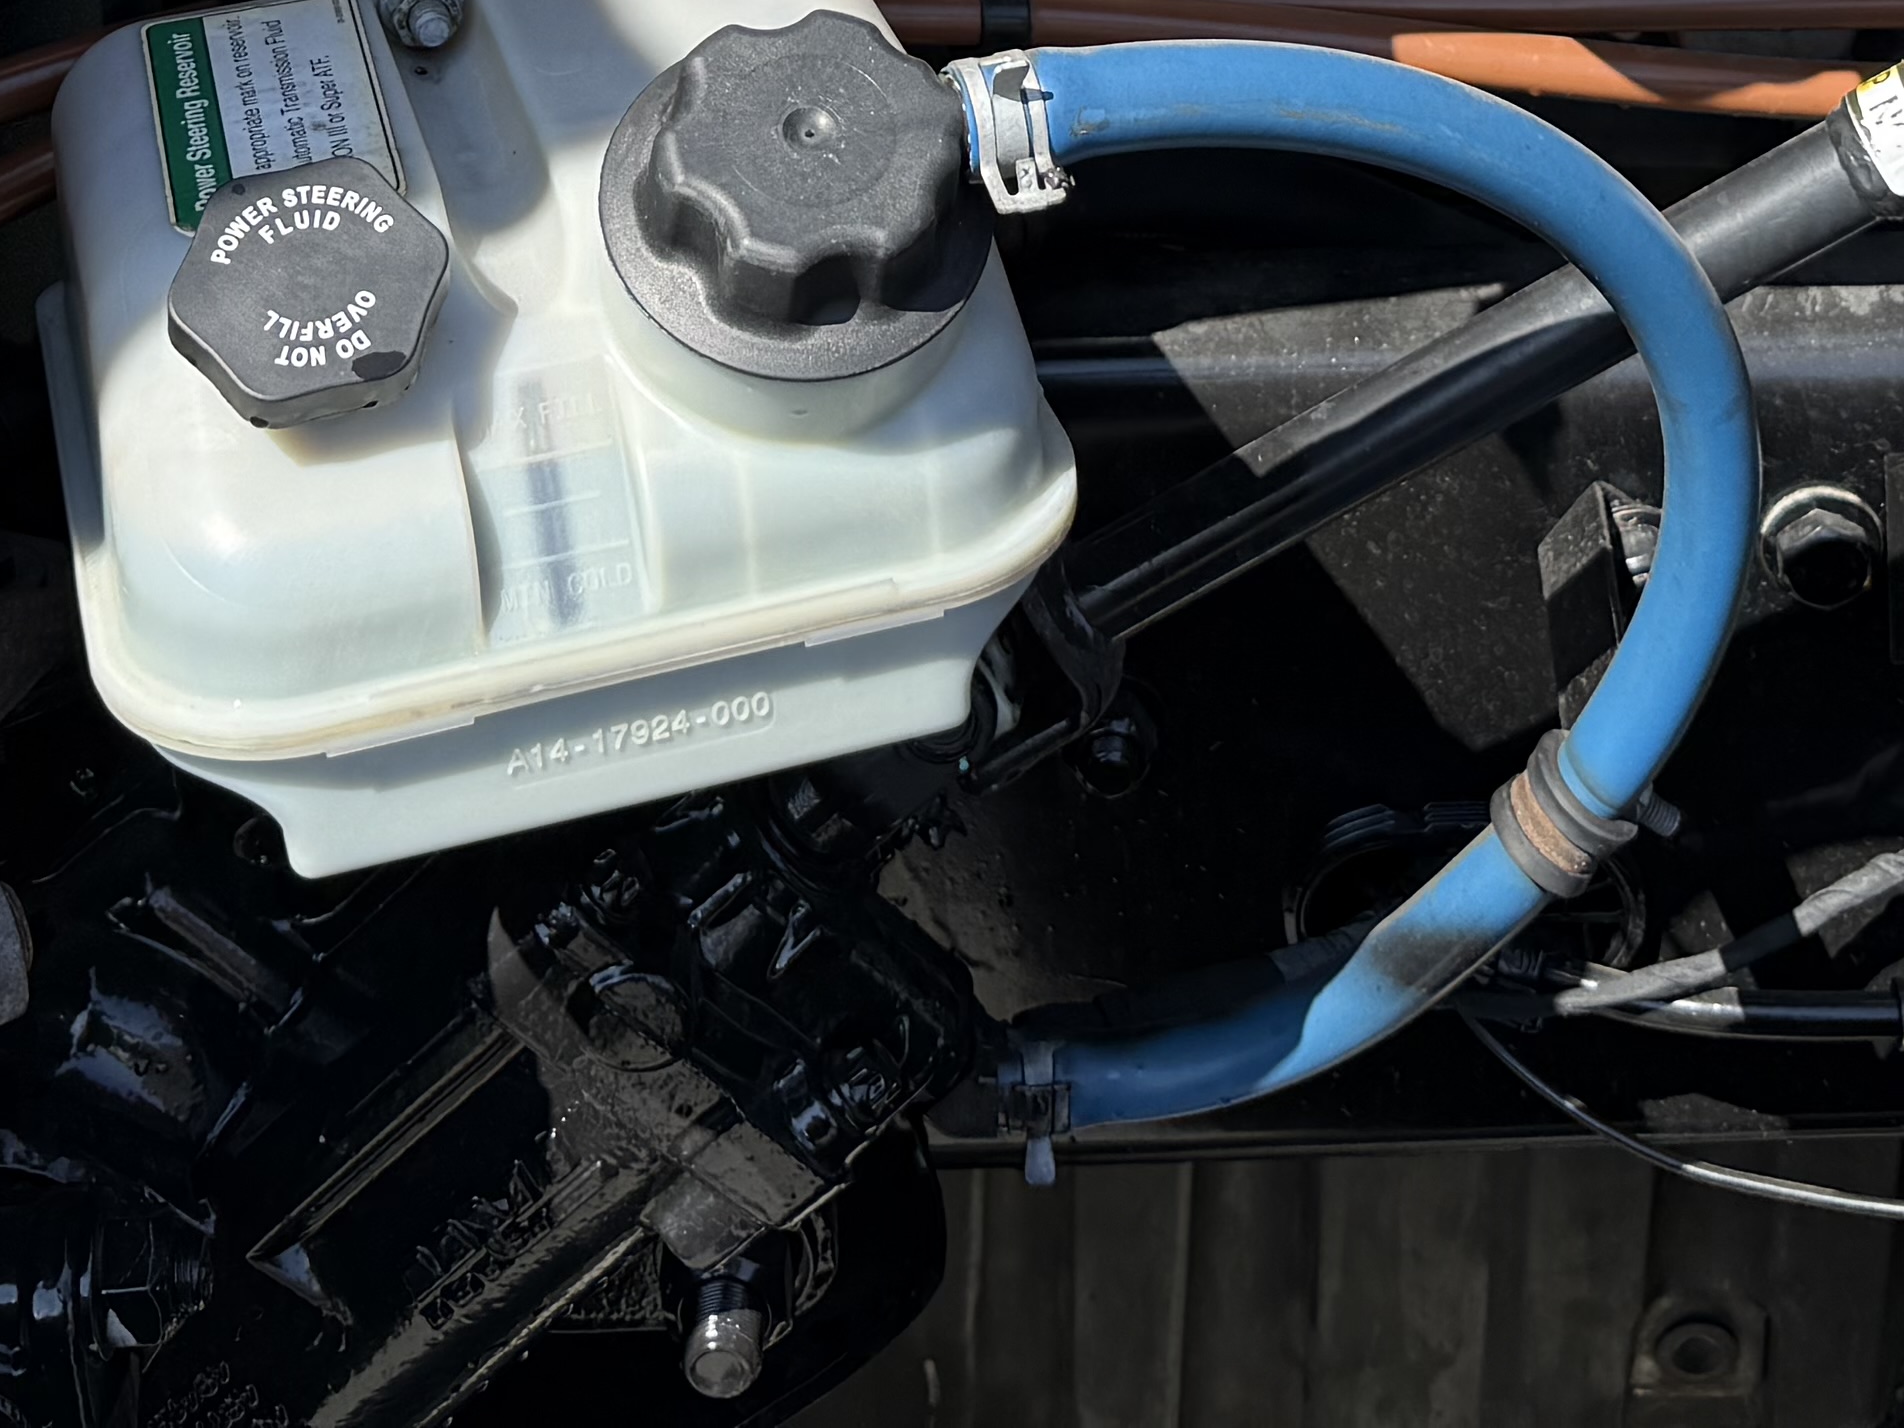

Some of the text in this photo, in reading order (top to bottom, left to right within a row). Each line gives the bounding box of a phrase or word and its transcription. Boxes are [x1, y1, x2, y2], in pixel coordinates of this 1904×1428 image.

[261, 19, 286, 48] Fluid
[235, 64, 254, 79] on
[276, 48, 302, 117] Transmission
[239, 83, 260, 112] mark
[319, 79, 345, 112] Super
[166, 31, 217, 212] Power Steering Reservoir
[328, 111, 346, 127] or
[242, 109, 272, 171] appropriate
[210, 184, 395, 265] POWER STEERING
[257, 209, 342, 245] FLUID
[263, 289, 377, 342] OVERFILL
[274, 329, 372, 367] DO NOT
[567, 562, 634, 596] COLD
[506, 690, 774, 777] A14-17924-000
